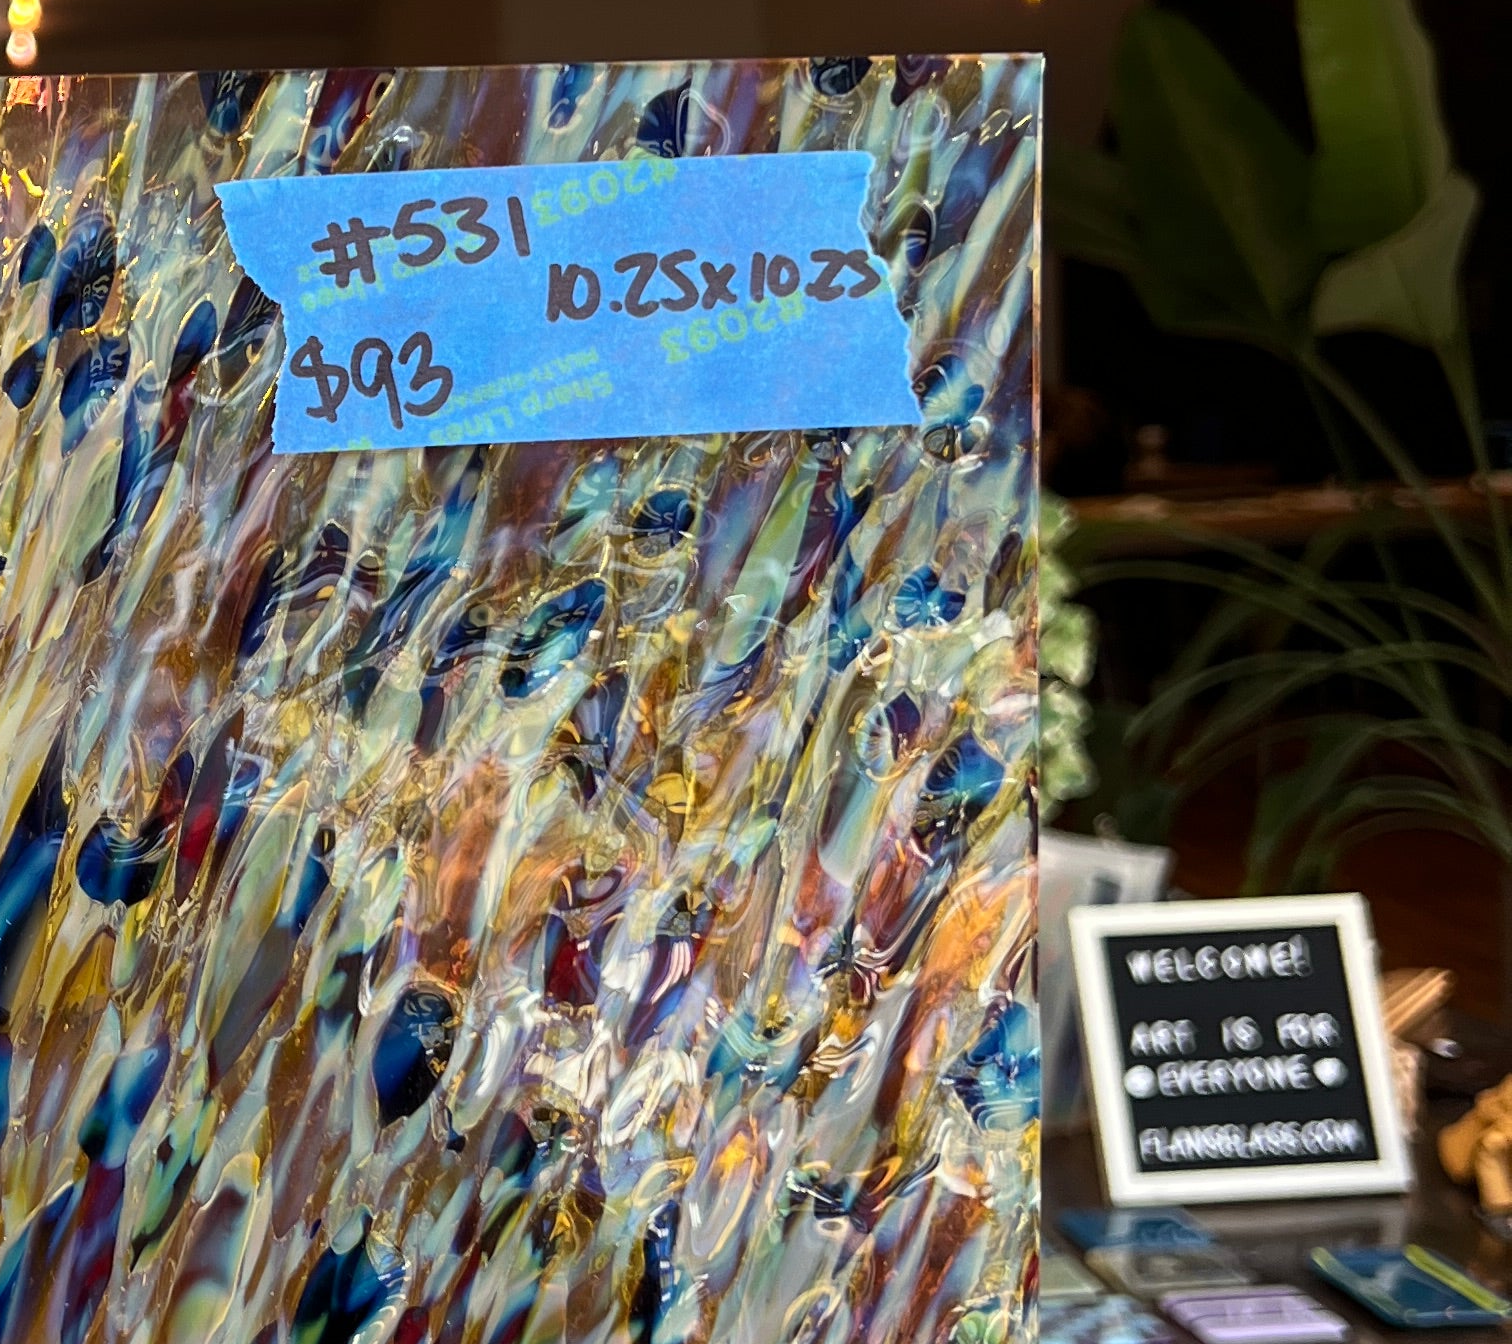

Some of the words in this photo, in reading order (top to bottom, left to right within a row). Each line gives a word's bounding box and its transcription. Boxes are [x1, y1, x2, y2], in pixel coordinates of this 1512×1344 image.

[530, 159, 678, 227] #2093
[311, 196, 532, 289] #531
[658, 290, 805, 364] #2093
[290, 331, 454, 429] $93
[521, 370, 613, 417] Sharp
[428, 405, 514, 445] Lines
[1125, 935, 1312, 985] WELCOME!
[1130, 1019, 1198, 1056] ART
[1221, 1016, 1263, 1052] IS
[1276, 1012, 1342, 1050] FOR
[1157, 1053, 1318, 1097] EVERYONE
